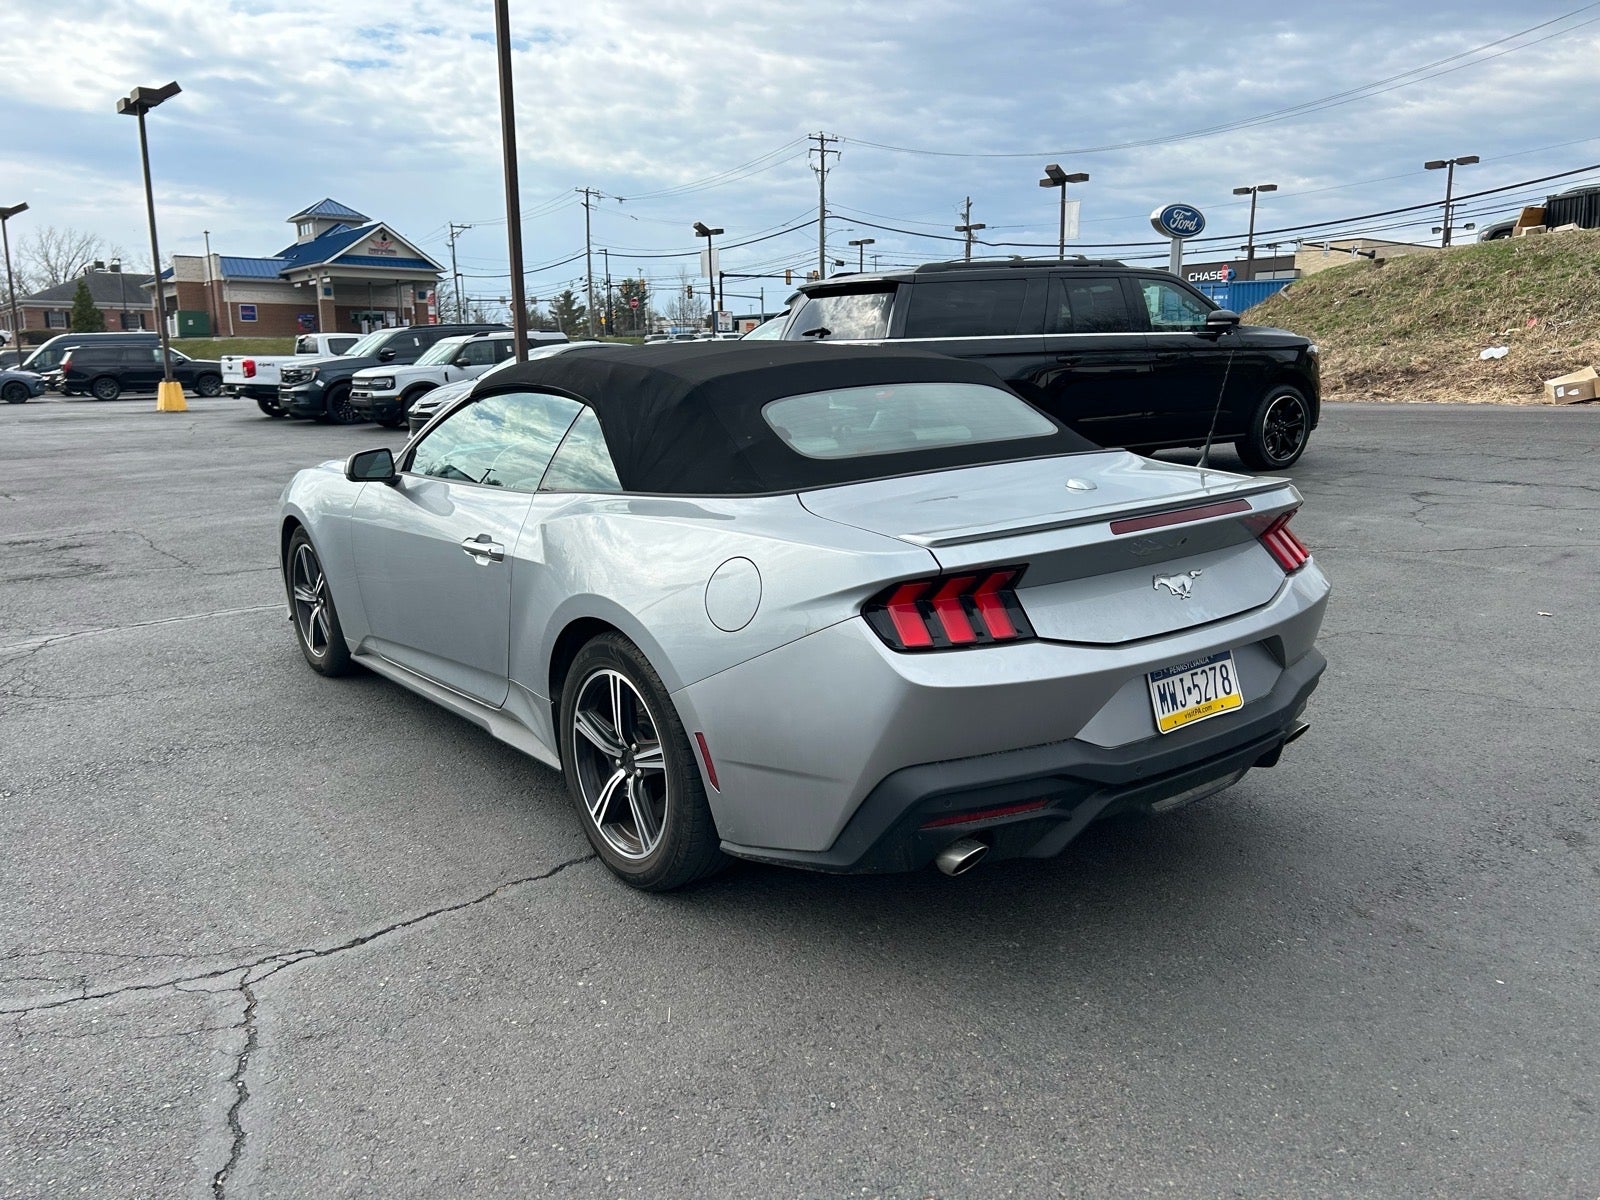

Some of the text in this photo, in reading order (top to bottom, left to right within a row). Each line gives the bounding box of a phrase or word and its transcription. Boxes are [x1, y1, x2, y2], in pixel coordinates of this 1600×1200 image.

[1170, 209, 1198, 231] Ford
[1188, 270, 1224, 281] CHASE
[1169, 657, 1209, 674] PENNSYLVANIA
[1184, 705, 1213, 719] visitPA.com
